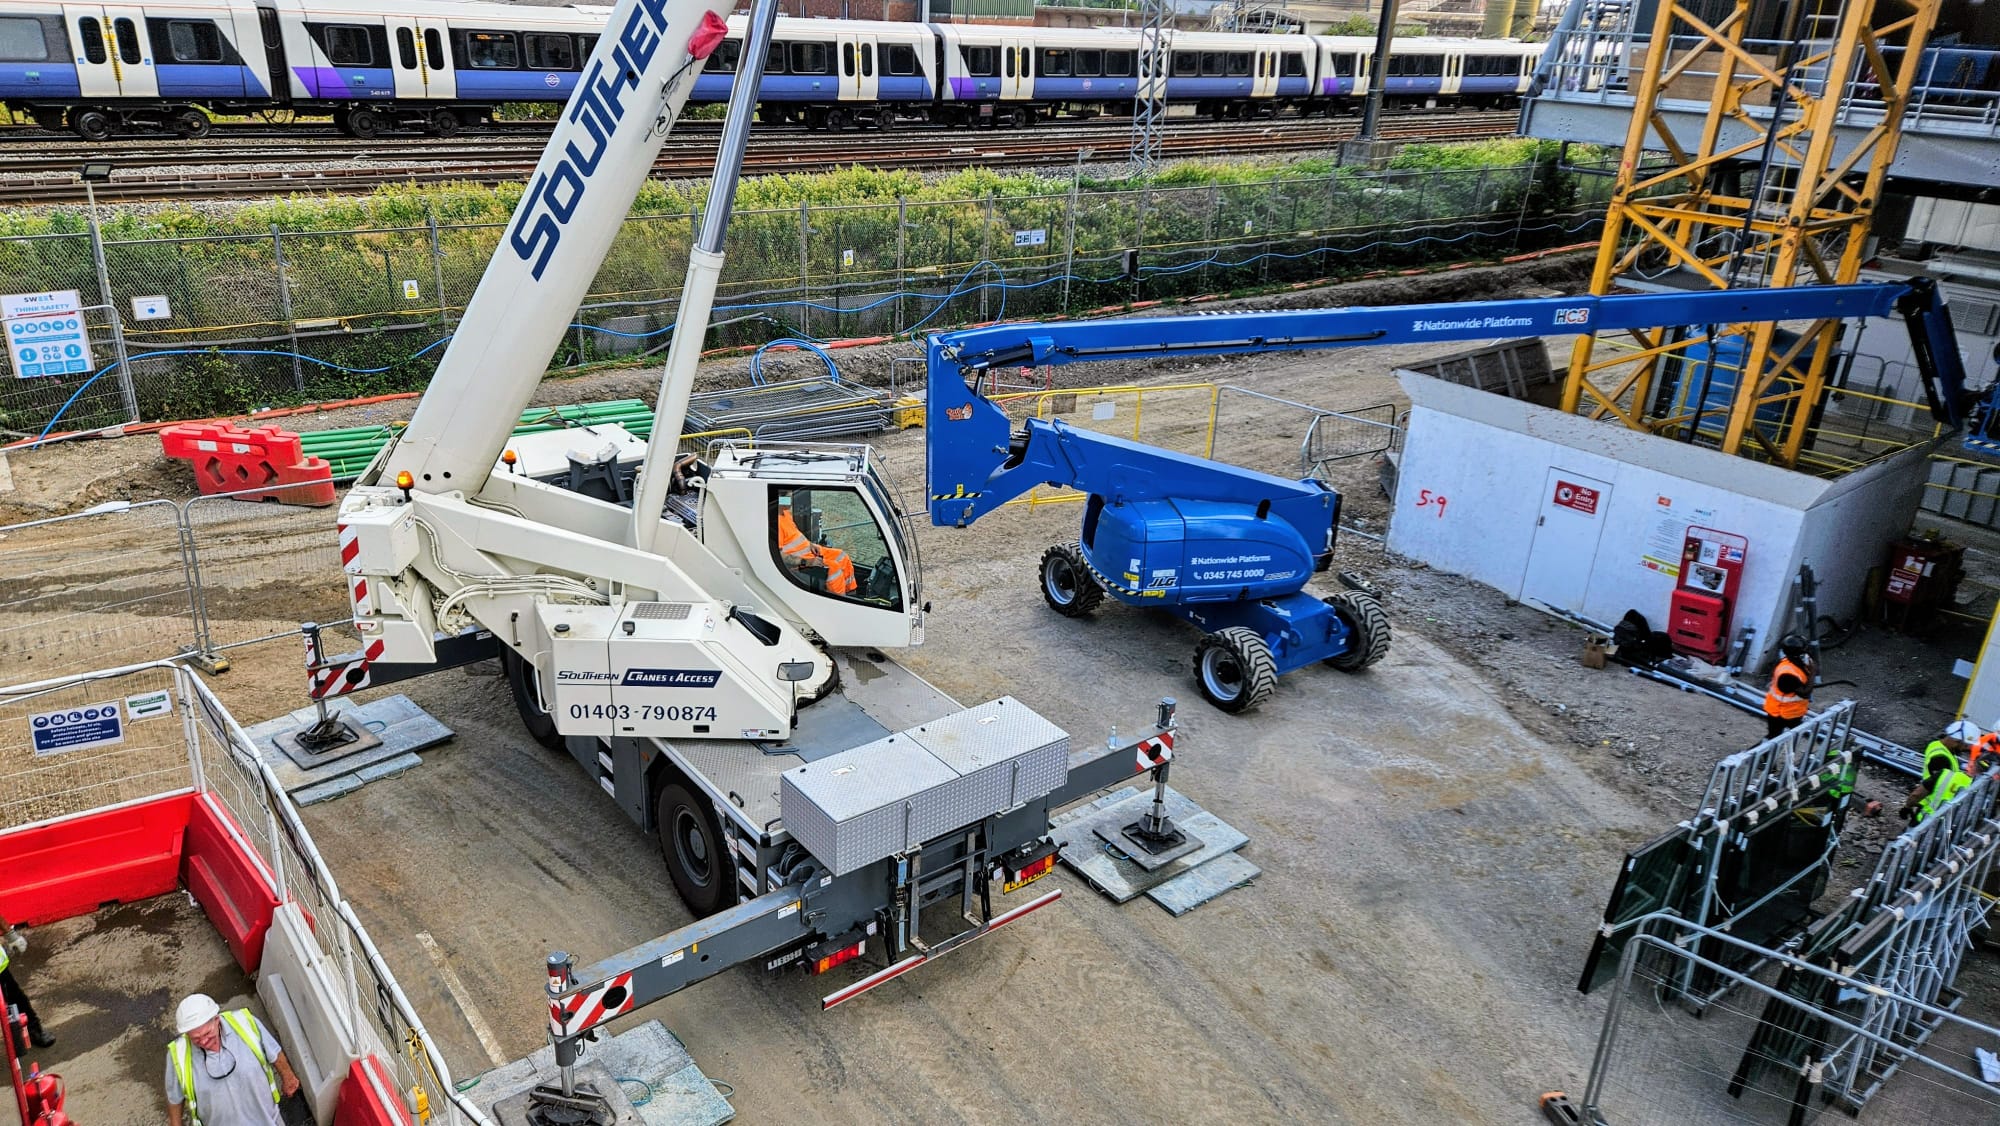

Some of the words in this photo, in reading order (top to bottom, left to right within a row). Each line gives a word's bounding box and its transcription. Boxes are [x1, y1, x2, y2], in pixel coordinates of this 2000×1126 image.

[14, 305, 39, 313] THINK
[40, 303, 70, 311] SAFETY
[1423, 318, 1482, 331] Nationwide
[1484, 316, 1533, 328] Platforms
[1554, 308, 1590, 325] HC3
[1580, 487, 1592, 496] No
[1575, 493, 1594, 505] Entry
[1198, 556, 1238, 565] Nationwide
[1239, 555, 1271, 563] Platforms
[1203, 571, 1225, 580] 0345
[1226, 570, 1242, 579] 745
[1243, 568, 1265, 578] 0000
[1148, 576, 1178, 588] JLG
